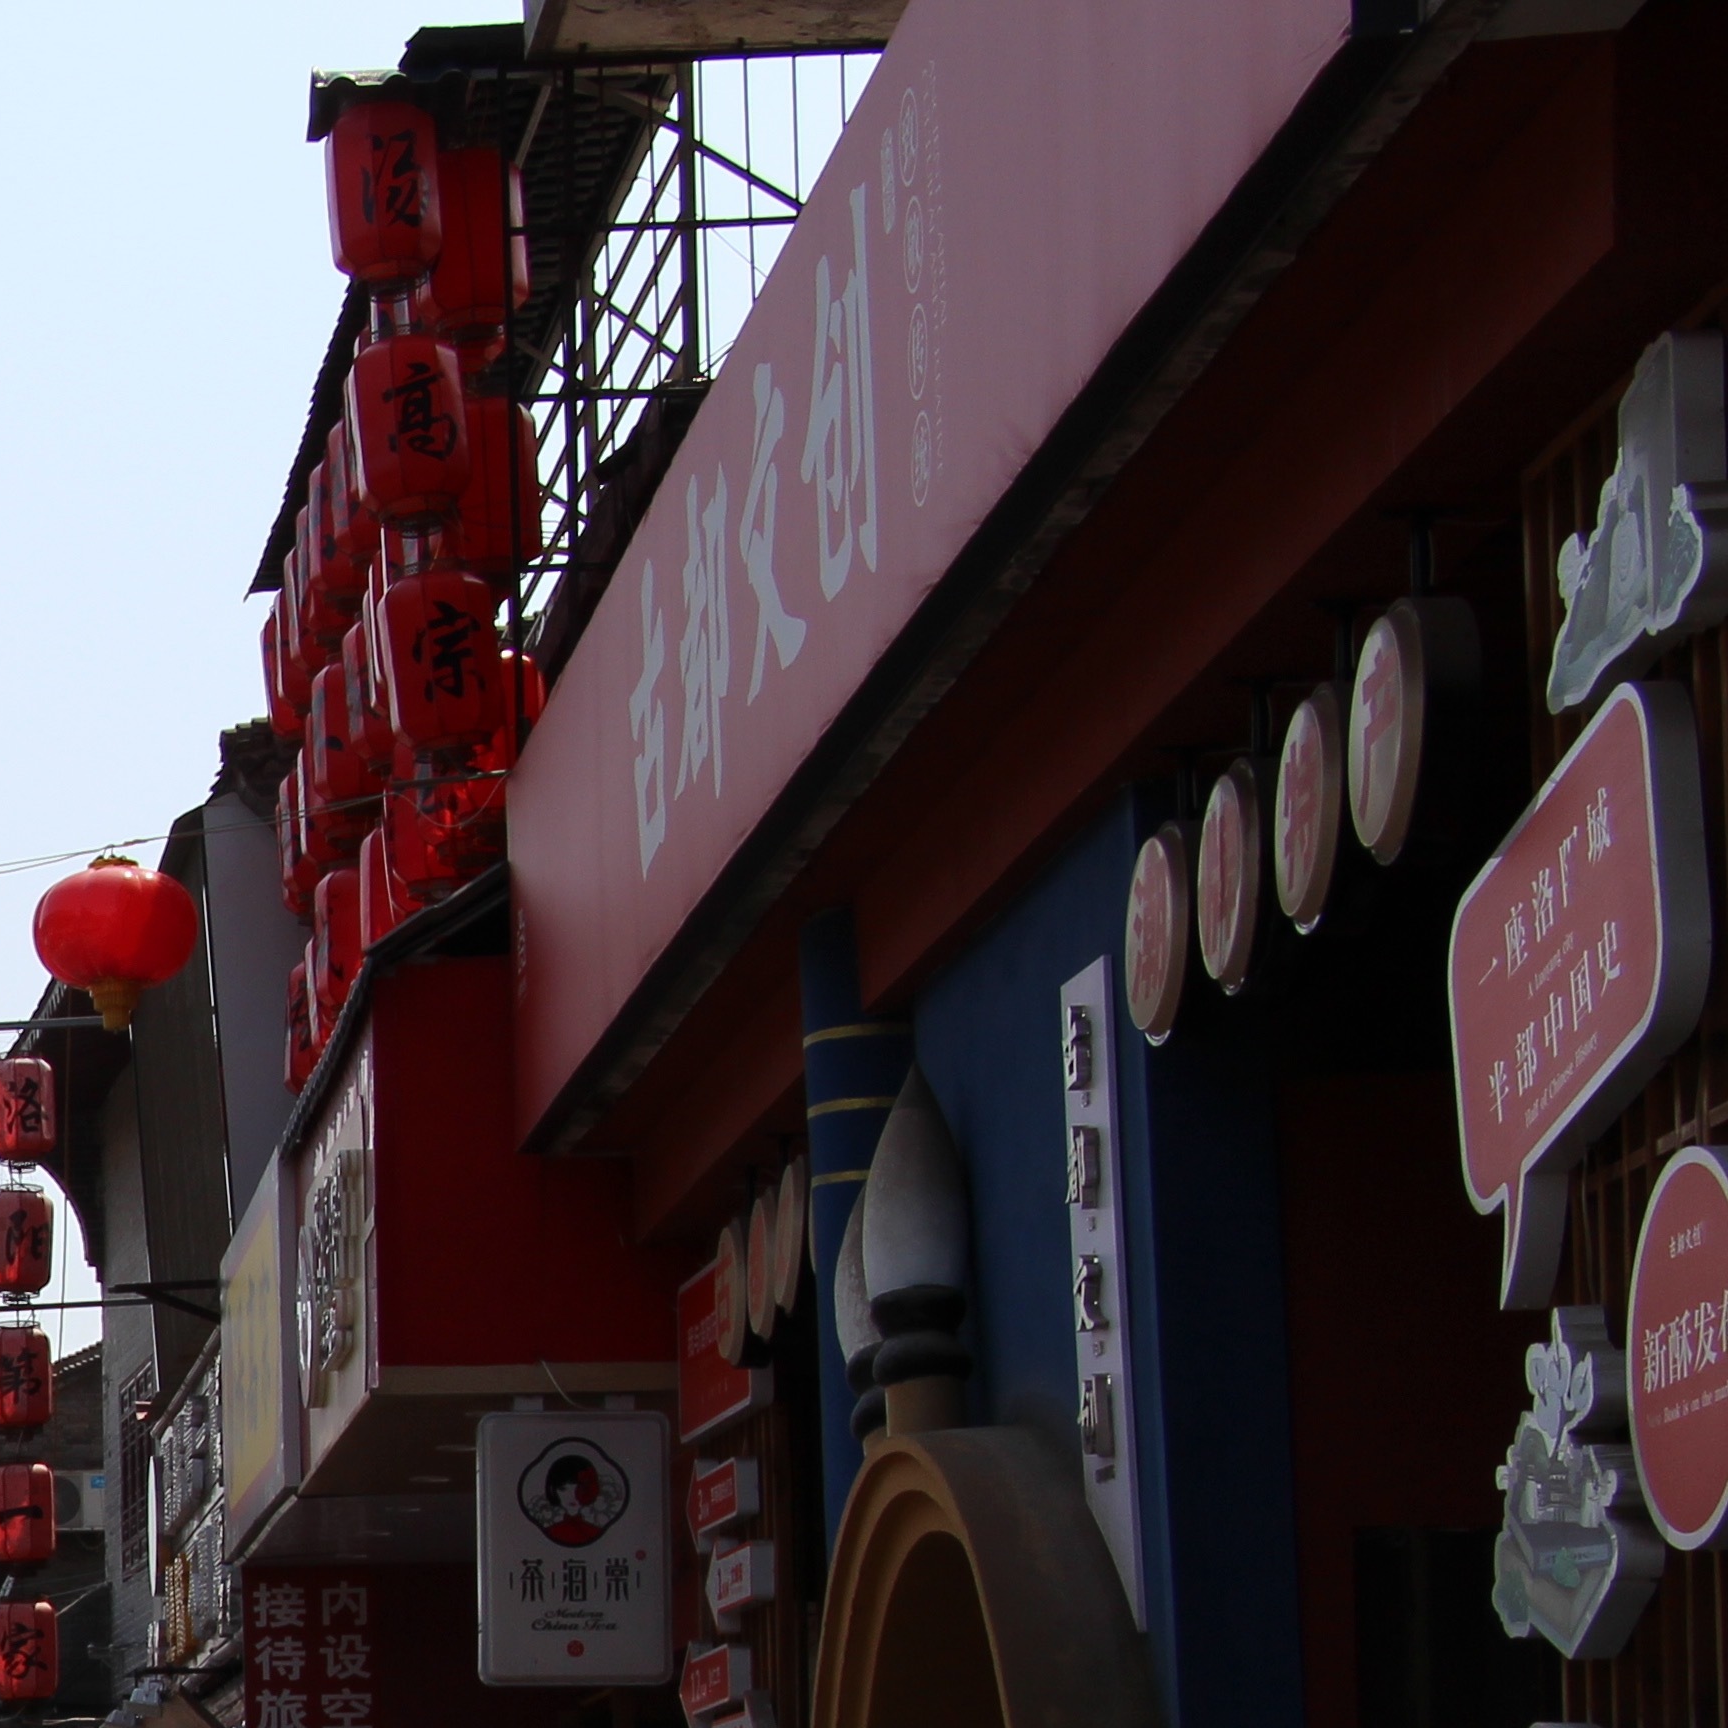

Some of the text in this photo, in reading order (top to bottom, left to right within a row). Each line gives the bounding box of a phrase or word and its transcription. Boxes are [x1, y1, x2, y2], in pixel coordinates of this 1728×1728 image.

[628, 181, 878, 880] 古都文创
[1490, 921, 1621, 1124] 半部中国史
[521, 1558, 630, 1601] 茶海棠
[531, 1619, 617, 1631] China Tea
